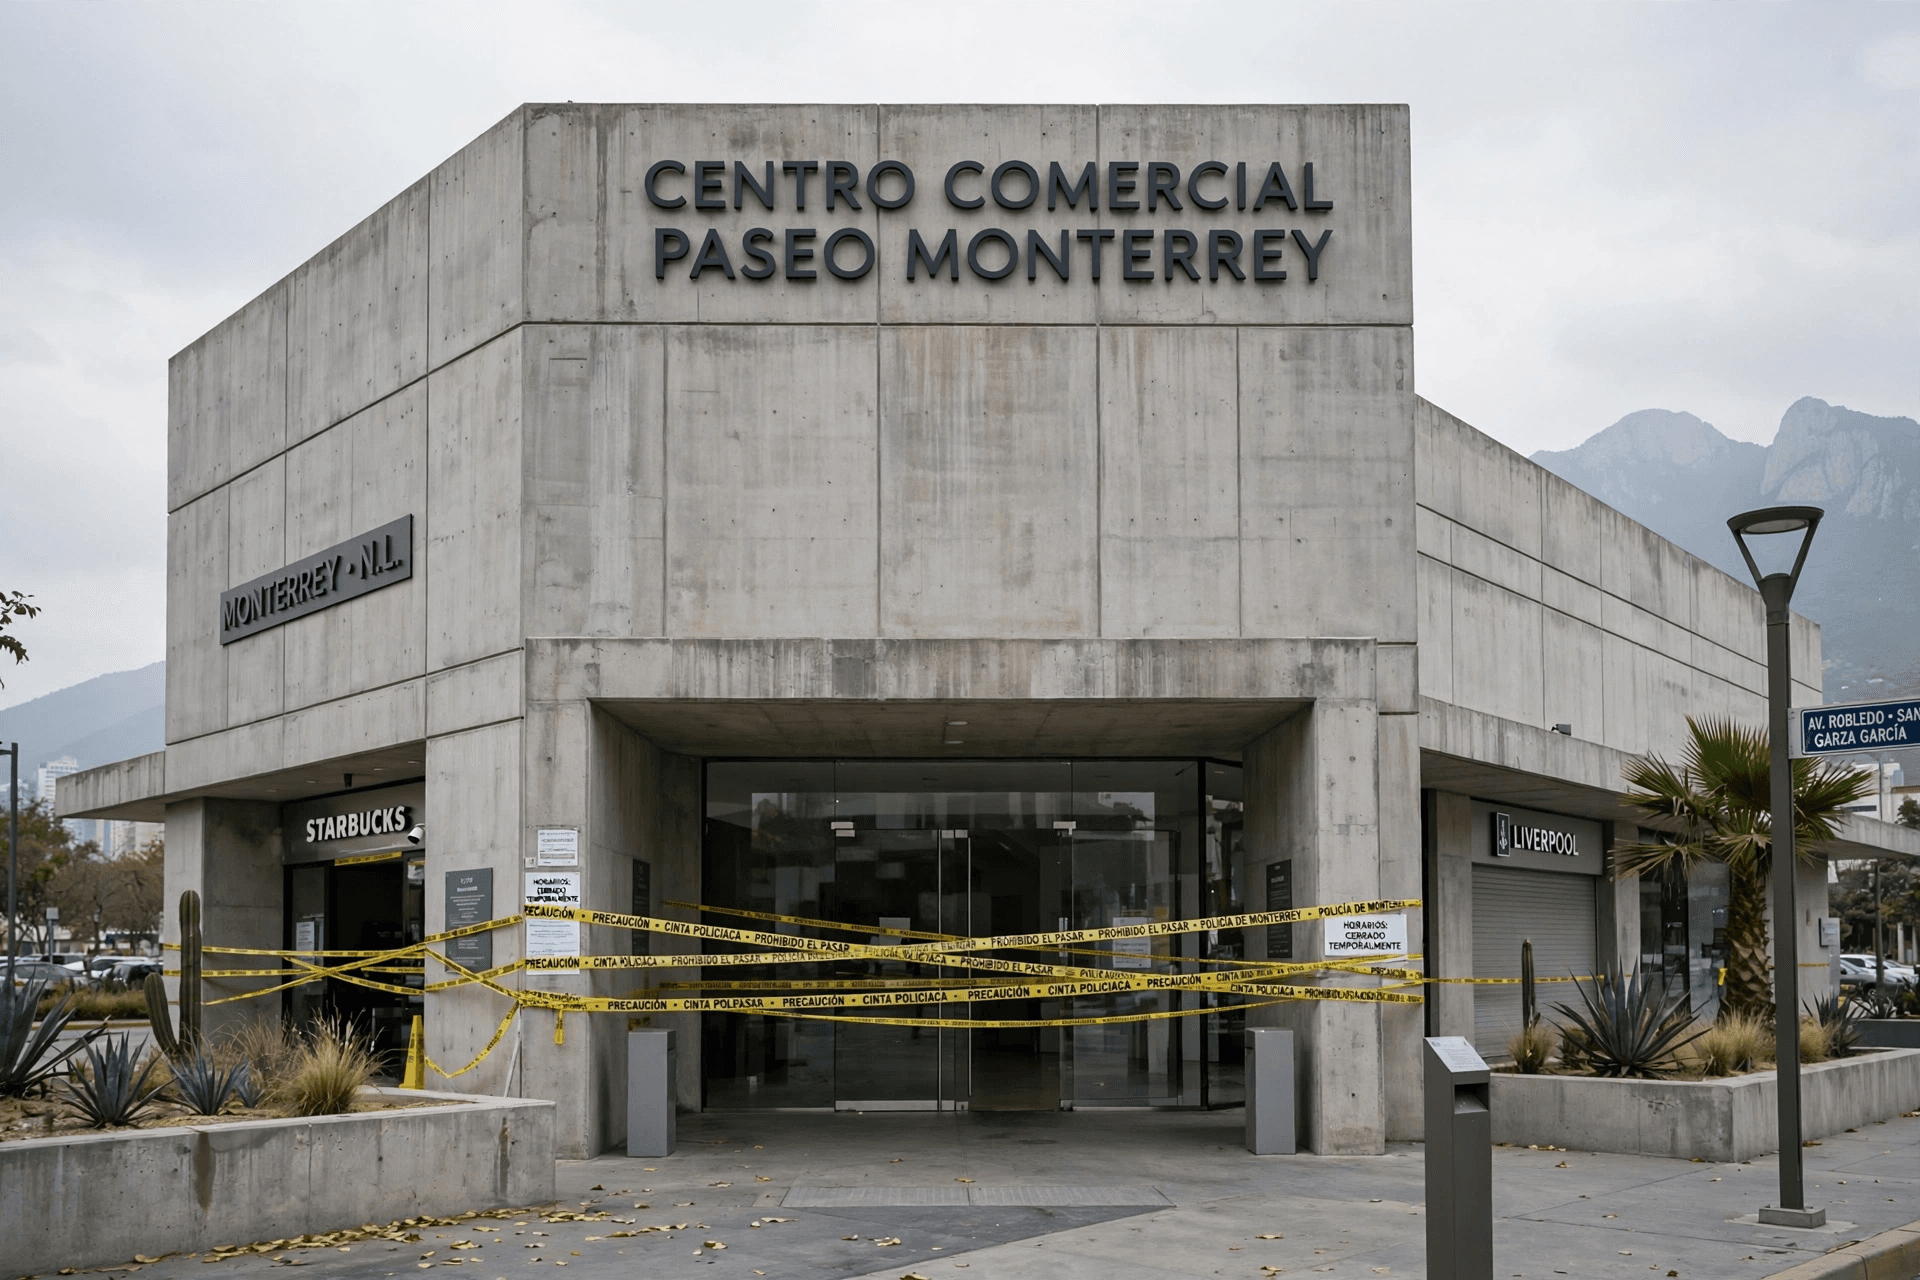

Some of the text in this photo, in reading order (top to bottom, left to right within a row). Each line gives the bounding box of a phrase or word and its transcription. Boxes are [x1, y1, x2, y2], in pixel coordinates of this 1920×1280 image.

[643, 159, 1334, 212] CENTRO COMERCIAL
[655, 226, 1334, 282] PASEO MONTERREY
[224, 534, 402, 631] MONTERREY N.L.
[1808, 716, 1826, 731] AV.
[1828, 710, 1885, 729] ROBLEDO
[1814, 723, 1908, 748] GARZA GARCÍA
[306, 805, 406, 843] STARBUCKS
[1513, 824, 1579, 856] LIVERPOOL
[592, 912, 650, 929] PRECAUCIÓN
[664, 921, 691, 934] CINTA
[693, 925, 741, 941] POLICIACA
[754, 933, 805, 948] PROHIBIDO
[807, 940, 818, 950] EL
[820, 941, 850, 953] PASAR
[960, 957, 1010, 971] PROHIBIDO
[1012, 962, 1024, 972] EL
[1025, 965, 1054, 975] PASAR
[991, 934, 1039, 947] PROHIBIDO
[1042, 933, 1054, 944] EL
[1055, 931, 1084, 943] PASAR
[1098, 925, 1146, 939] PROHIBIDO
[1148, 924, 1159, 935] EL
[1161, 920, 1190, 932] PASAR
[1235, 915, 1248, 926] DE
[1249, 910, 1302, 924] MONTERREY
[1354, 902, 1366, 914] DE
[525, 956, 580, 969] PRECAUCIÓN
[671, 955, 718, 966] PROHIBIDO
[720, 954, 731, 964] EL
[732, 954, 761, 965] PASAR
[607, 1000, 668, 1011] PRECAUCIÓN
[683, 999, 711, 1010] CINTA
[782, 994, 845, 1008] PRECAUCIÓN
[862, 994, 892, 1006] CINTA
[895, 991, 948, 1004] POLICIACA
[968, 985, 1030, 1000] PRECAUCIÓN
[1048, 984, 1077, 996] CINTA
[1080, 980, 1131, 993] POLICIACA
[1147, 974, 1202, 988] PRECAUCIÓN
[1216, 972, 1239, 982] CINTA
